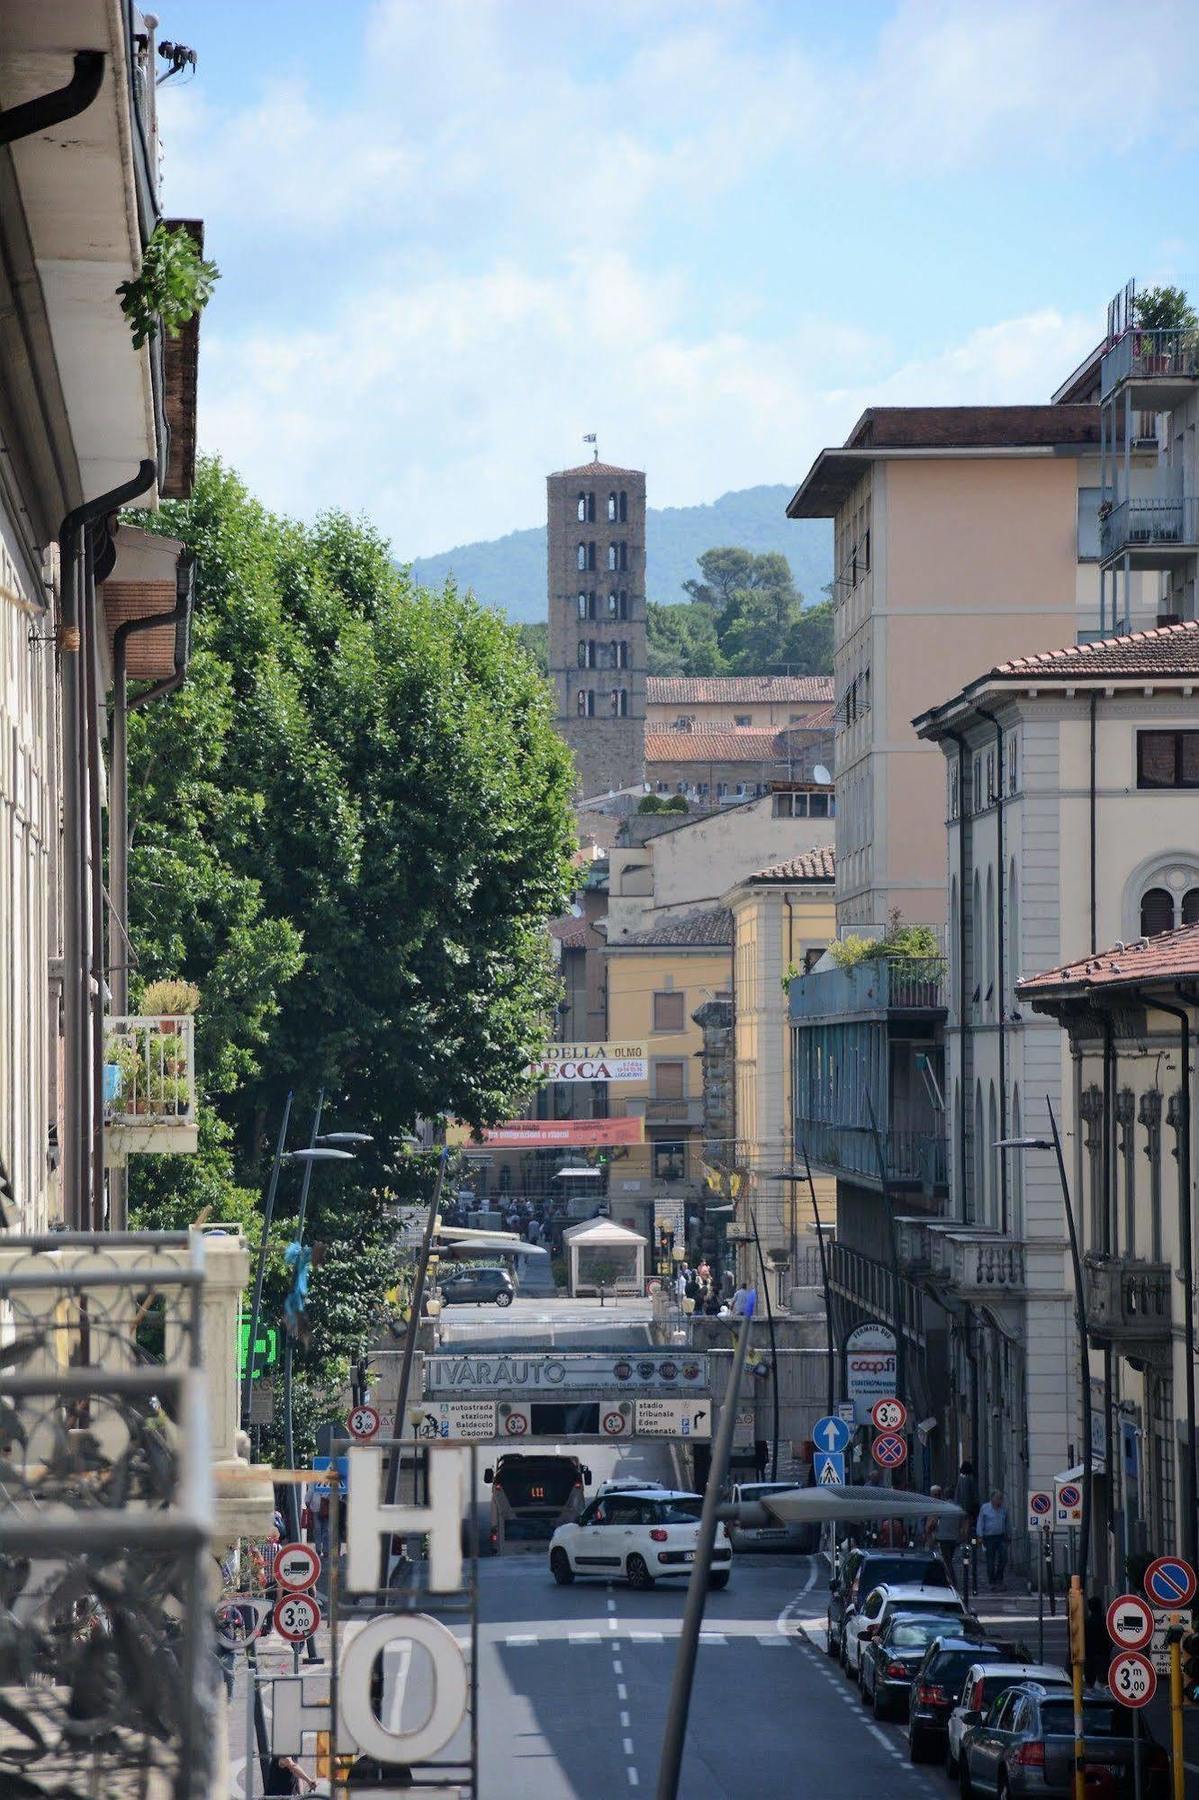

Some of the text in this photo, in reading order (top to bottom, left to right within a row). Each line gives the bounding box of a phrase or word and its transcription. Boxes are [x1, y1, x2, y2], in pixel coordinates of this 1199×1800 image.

[547, 1046, 607, 1059] DELLA
[614, 1047, 642, 1058] OLMO
[851, 1357, 895, 1374] coop.fi
[435, 1360, 566, 1386] IVARAUTO
[451, 1404, 493, 1412] autostrada
[639, 1410, 674, 1418] tribunale
[461, 1429, 493, 1437] Cadorna
[638, 1427, 677, 1435] Mecenate
[341, 1446, 467, 1800] HO
